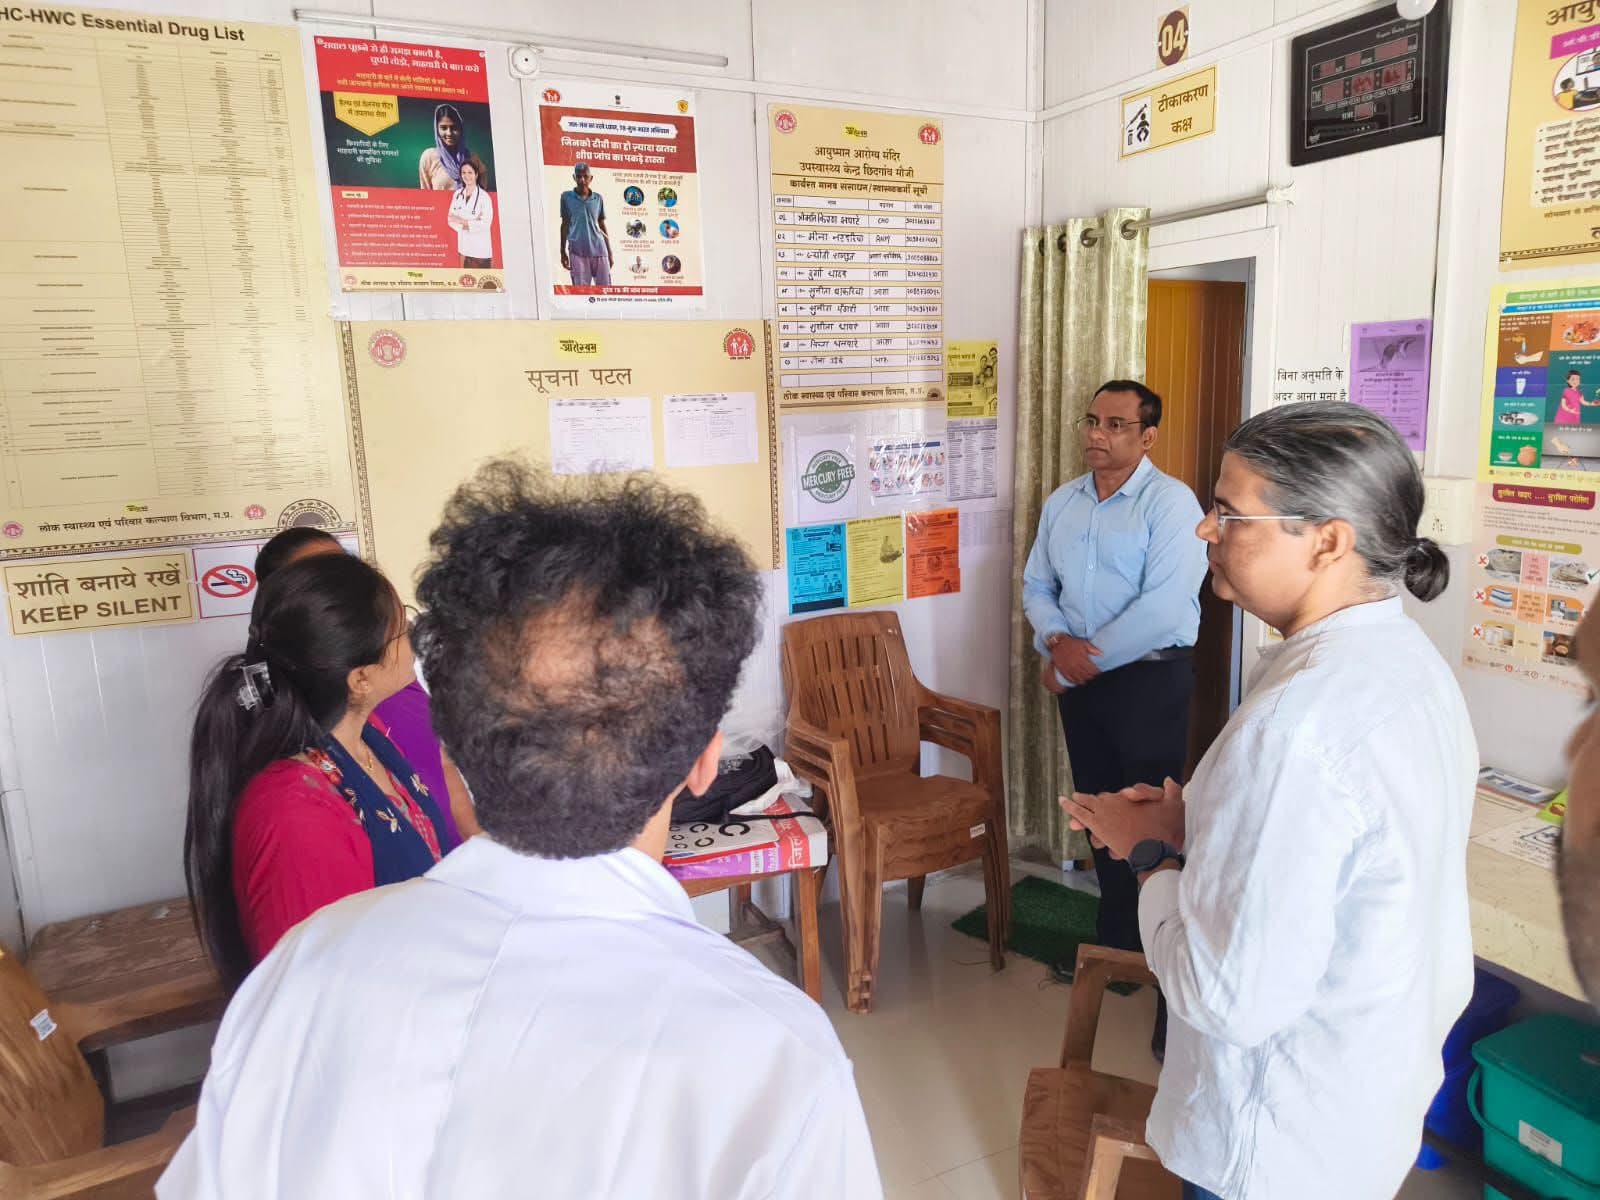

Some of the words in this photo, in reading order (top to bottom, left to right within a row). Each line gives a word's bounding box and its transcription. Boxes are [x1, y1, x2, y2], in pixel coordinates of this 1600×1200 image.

[82, 13, 163, 34] Essential
[168, 21, 209, 41] Drug
[214, 26, 245, 41] List
[1161, 18, 1186, 57] 04
[1157, 84, 1209, 113] टीकाकरण
[1171, 116, 1193, 134] कक्ष
[815, 146, 850, 160] आयुष्मान
[854, 147, 879, 159] आरोग्य
[882, 148, 901, 161] मंदिर
[799, 161, 841, 174] उपस्वास्थ्य
[843, 161, 861, 177] केन्द्र
[524, 369, 579, 394] सूचना
[589, 368, 632, 386] पटल
[1278, 368, 1298, 381] बिना
[1301, 366, 1332, 384] अनुमति
[1335, 366, 1344, 381] के
[802, 471, 836, 489] MERCURY
[837, 465, 855, 480] FREE
[38, 521, 60, 532] लोक
[64, 522, 95, 531] स्वास्थ्य
[98, 518, 112, 529] एवं
[114, 517, 142, 528] परिवार
[146, 514, 178, 524] कल्याण
[14, 573, 70, 599] शांति
[76, 567, 137, 592] बनाये
[144, 563, 181, 588] रखें
[20, 604, 89, 625] KEEP
[96, 595, 182, 618] SILENT
